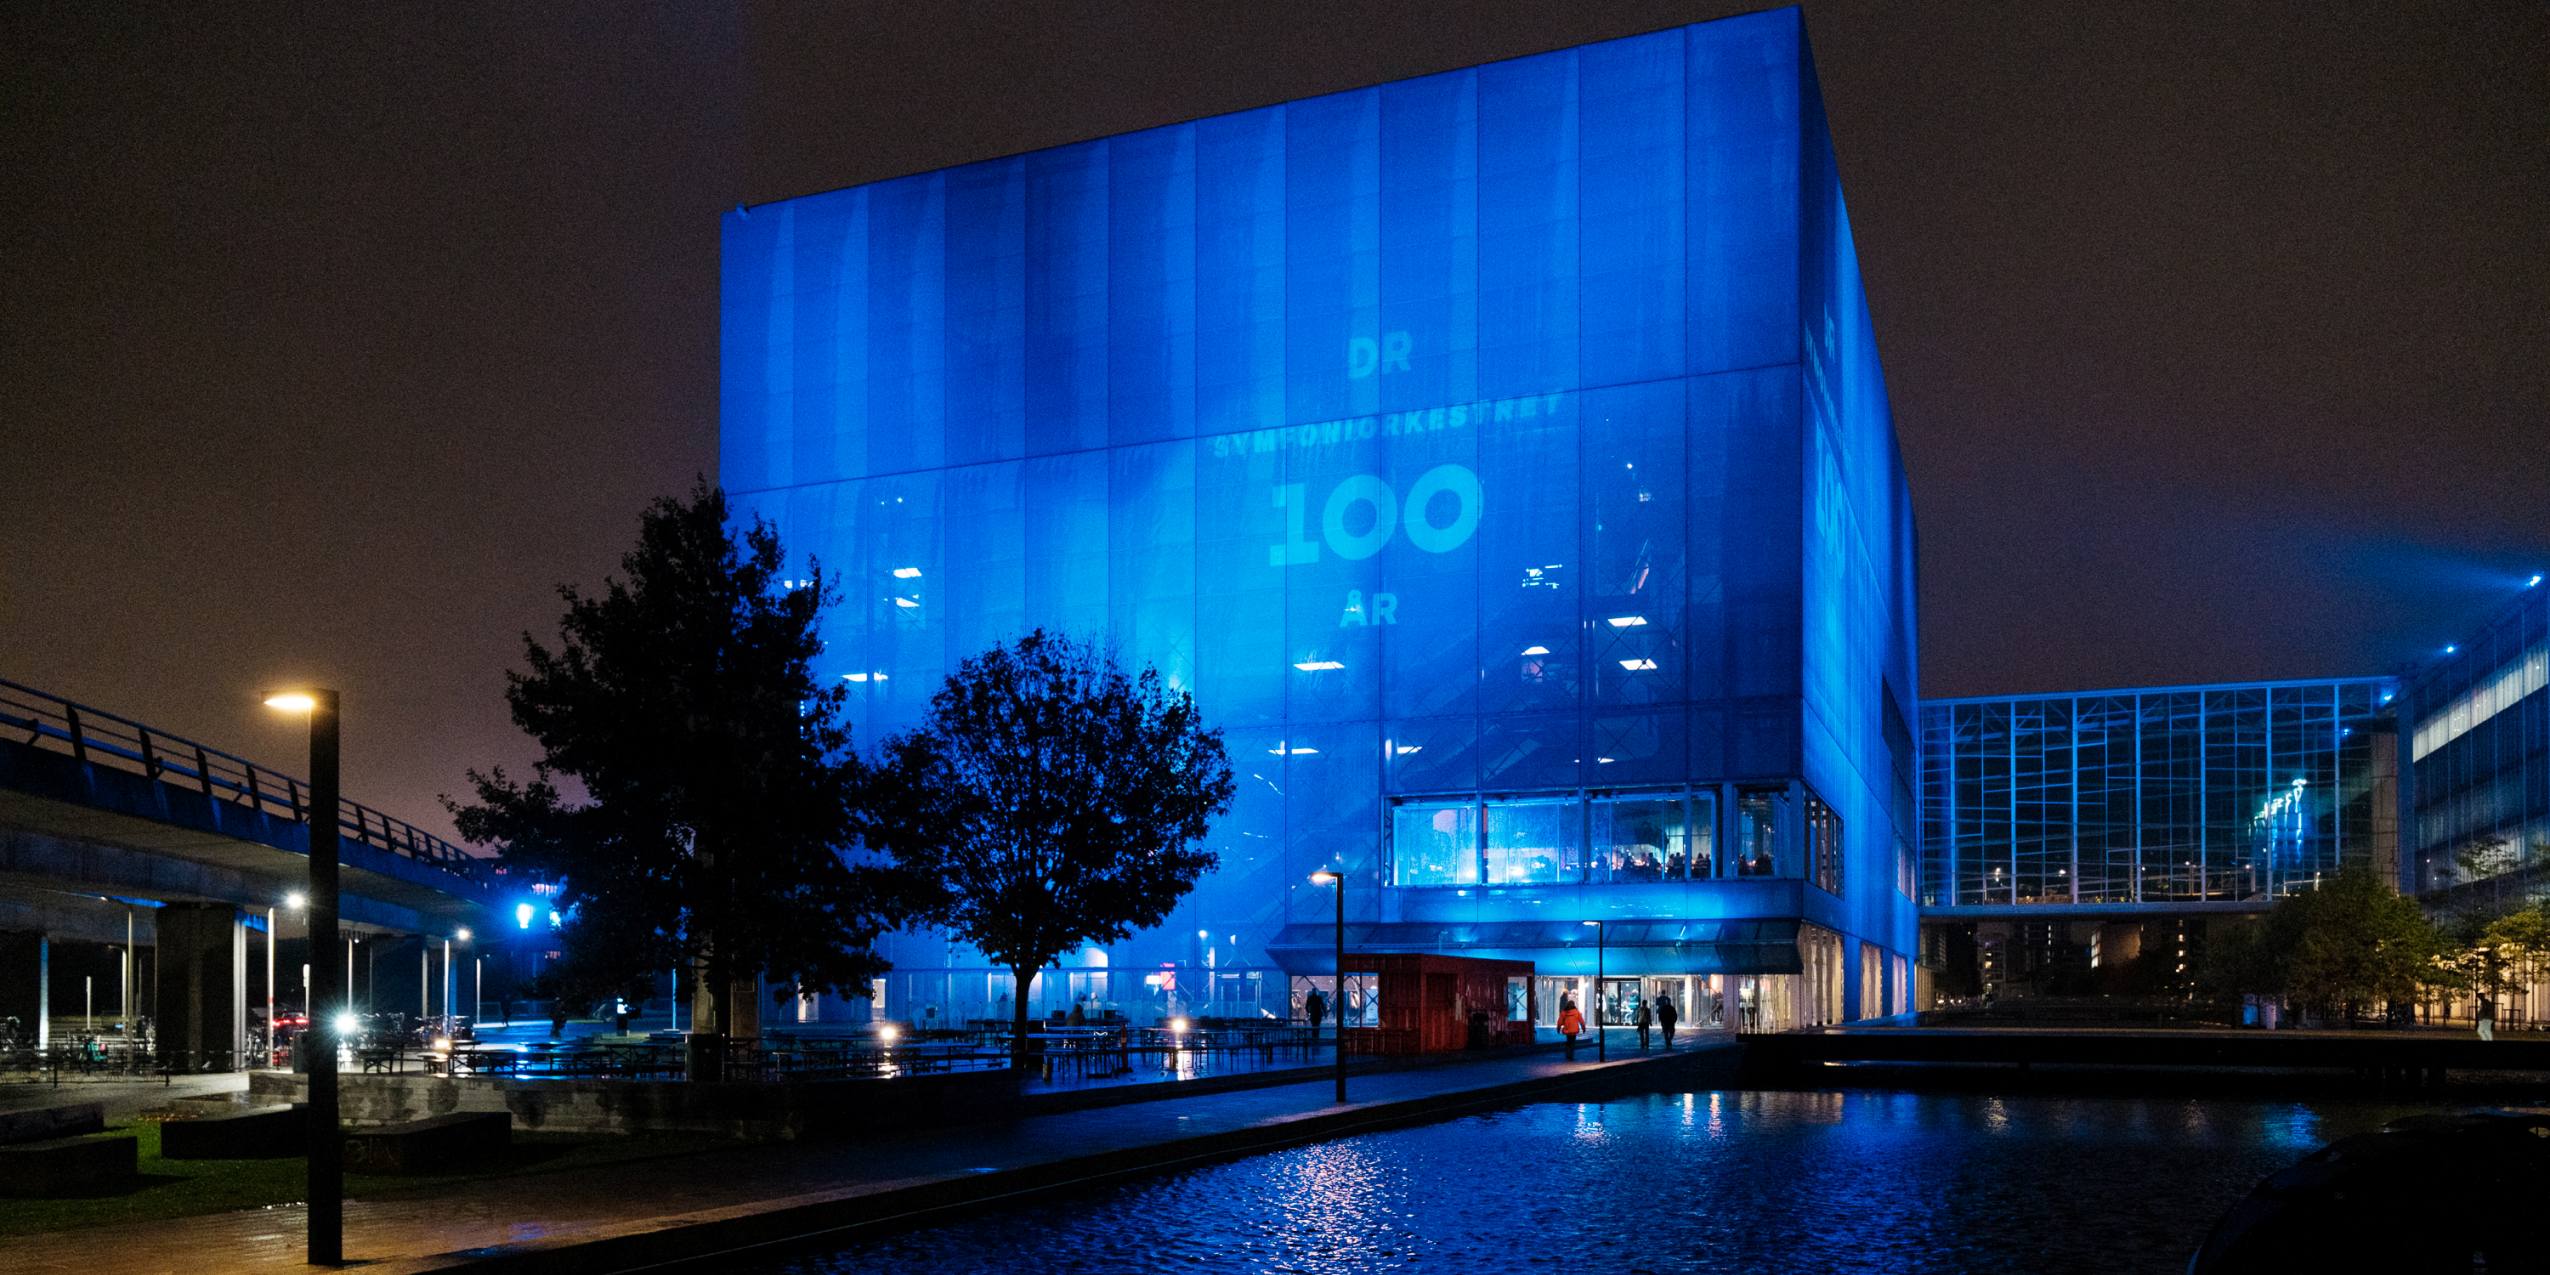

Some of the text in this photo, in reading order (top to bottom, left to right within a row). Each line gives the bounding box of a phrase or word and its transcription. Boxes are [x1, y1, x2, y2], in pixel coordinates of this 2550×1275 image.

[1348, 330, 1413, 380] DR
[1269, 463, 1485, 567] 100
[1339, 590, 1399, 628] ÅR
